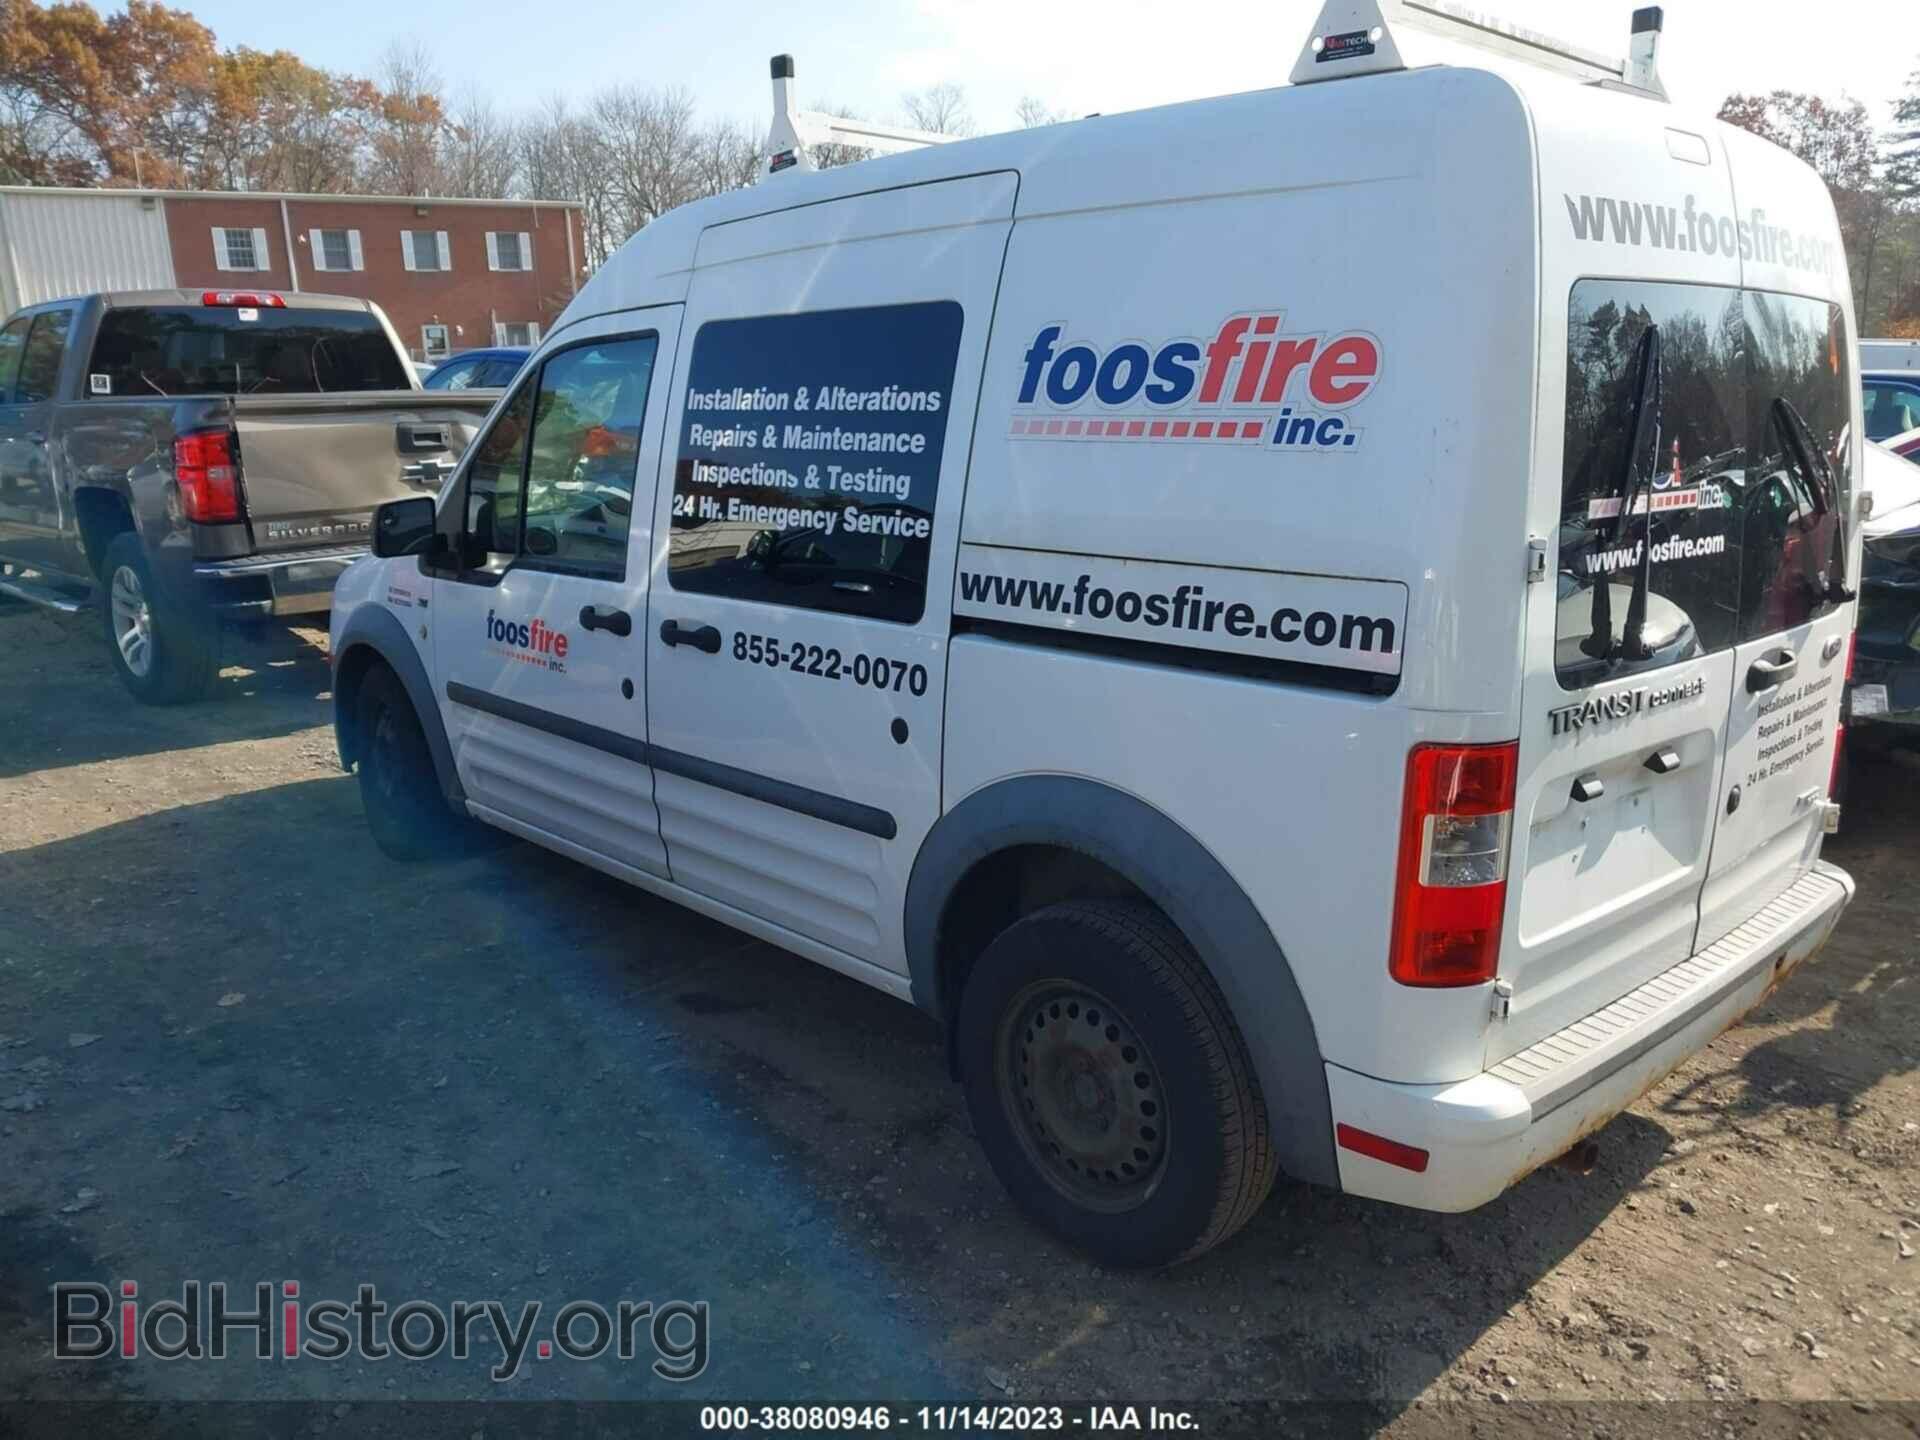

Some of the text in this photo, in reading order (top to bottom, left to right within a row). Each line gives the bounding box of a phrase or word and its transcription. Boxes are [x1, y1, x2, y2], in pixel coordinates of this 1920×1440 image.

[1018, 316, 1379, 404] foosfire
[687, 385, 942, 412] Installation & Alterations
[689, 424, 926, 453] Repairs & Maintenance
[1272, 408, 1356, 446] inc.
[692, 459, 911, 500] Inspections & Testing
[672, 495, 930, 539] 24 Hr. Emergency Service
[1586, 534, 1725, 574] www.fosfire.com
[961, 572, 1396, 654] www.foosfire.com
[487, 609, 568, 657] foosfire
[549, 656, 567, 674] inc.
[733, 631, 928, 697] 855-222-0070
[1650, 677, 1706, 708] connect
[1757, 691, 1796, 718] Installation
[1757, 718, 1785, 740] Repairs
[1757, 734, 1796, 761] Inspections
[1746, 772, 1757, 787] 24
[1770, 749, 1805, 776] Emergency
